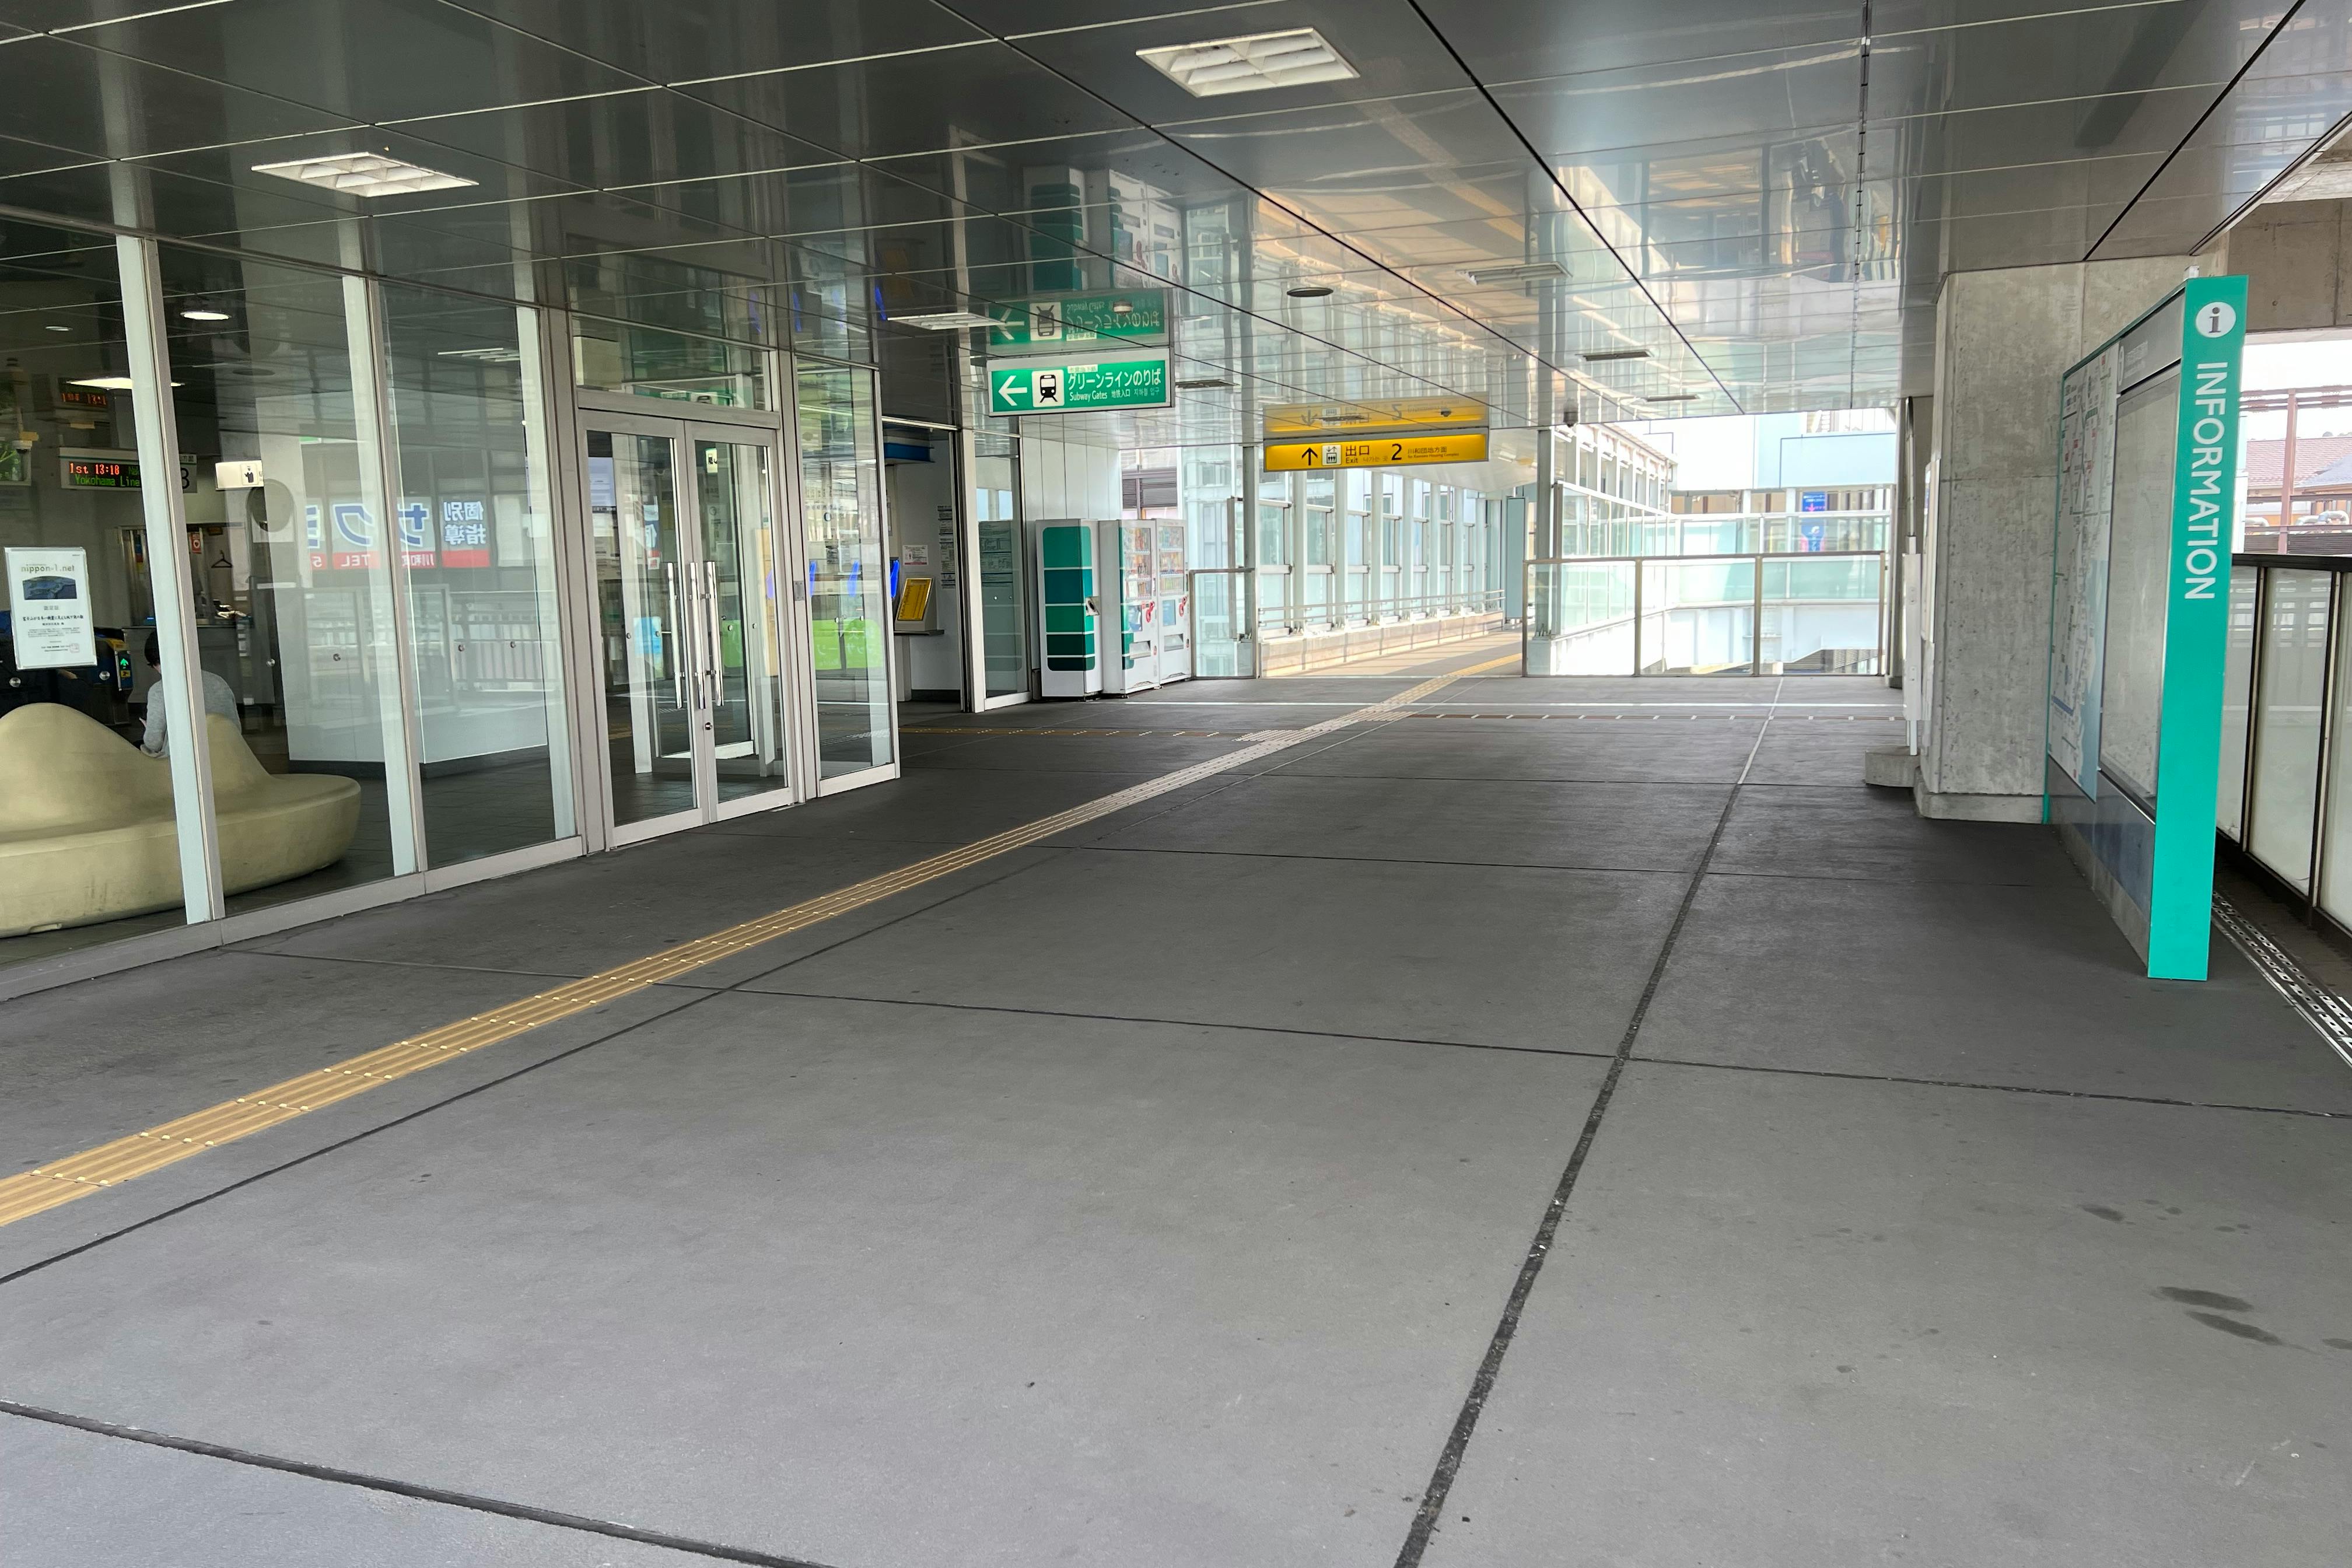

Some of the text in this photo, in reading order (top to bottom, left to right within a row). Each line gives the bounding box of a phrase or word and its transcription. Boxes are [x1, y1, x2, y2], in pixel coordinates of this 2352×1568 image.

[1068, 368, 1161, 390] グリーンラインのりば
[1070, 390, 1107, 402] Subway Gates
[1346, 445, 1370, 456] 出口
[1391, 443, 1402, 460] 2
[69, 463, 88, 474] 1st
[75, 474, 141, 487] Yokohama Line
[2185, 362, 2228, 599] INFORMATION
[21, 564, 75, 573] nippon-1.net
